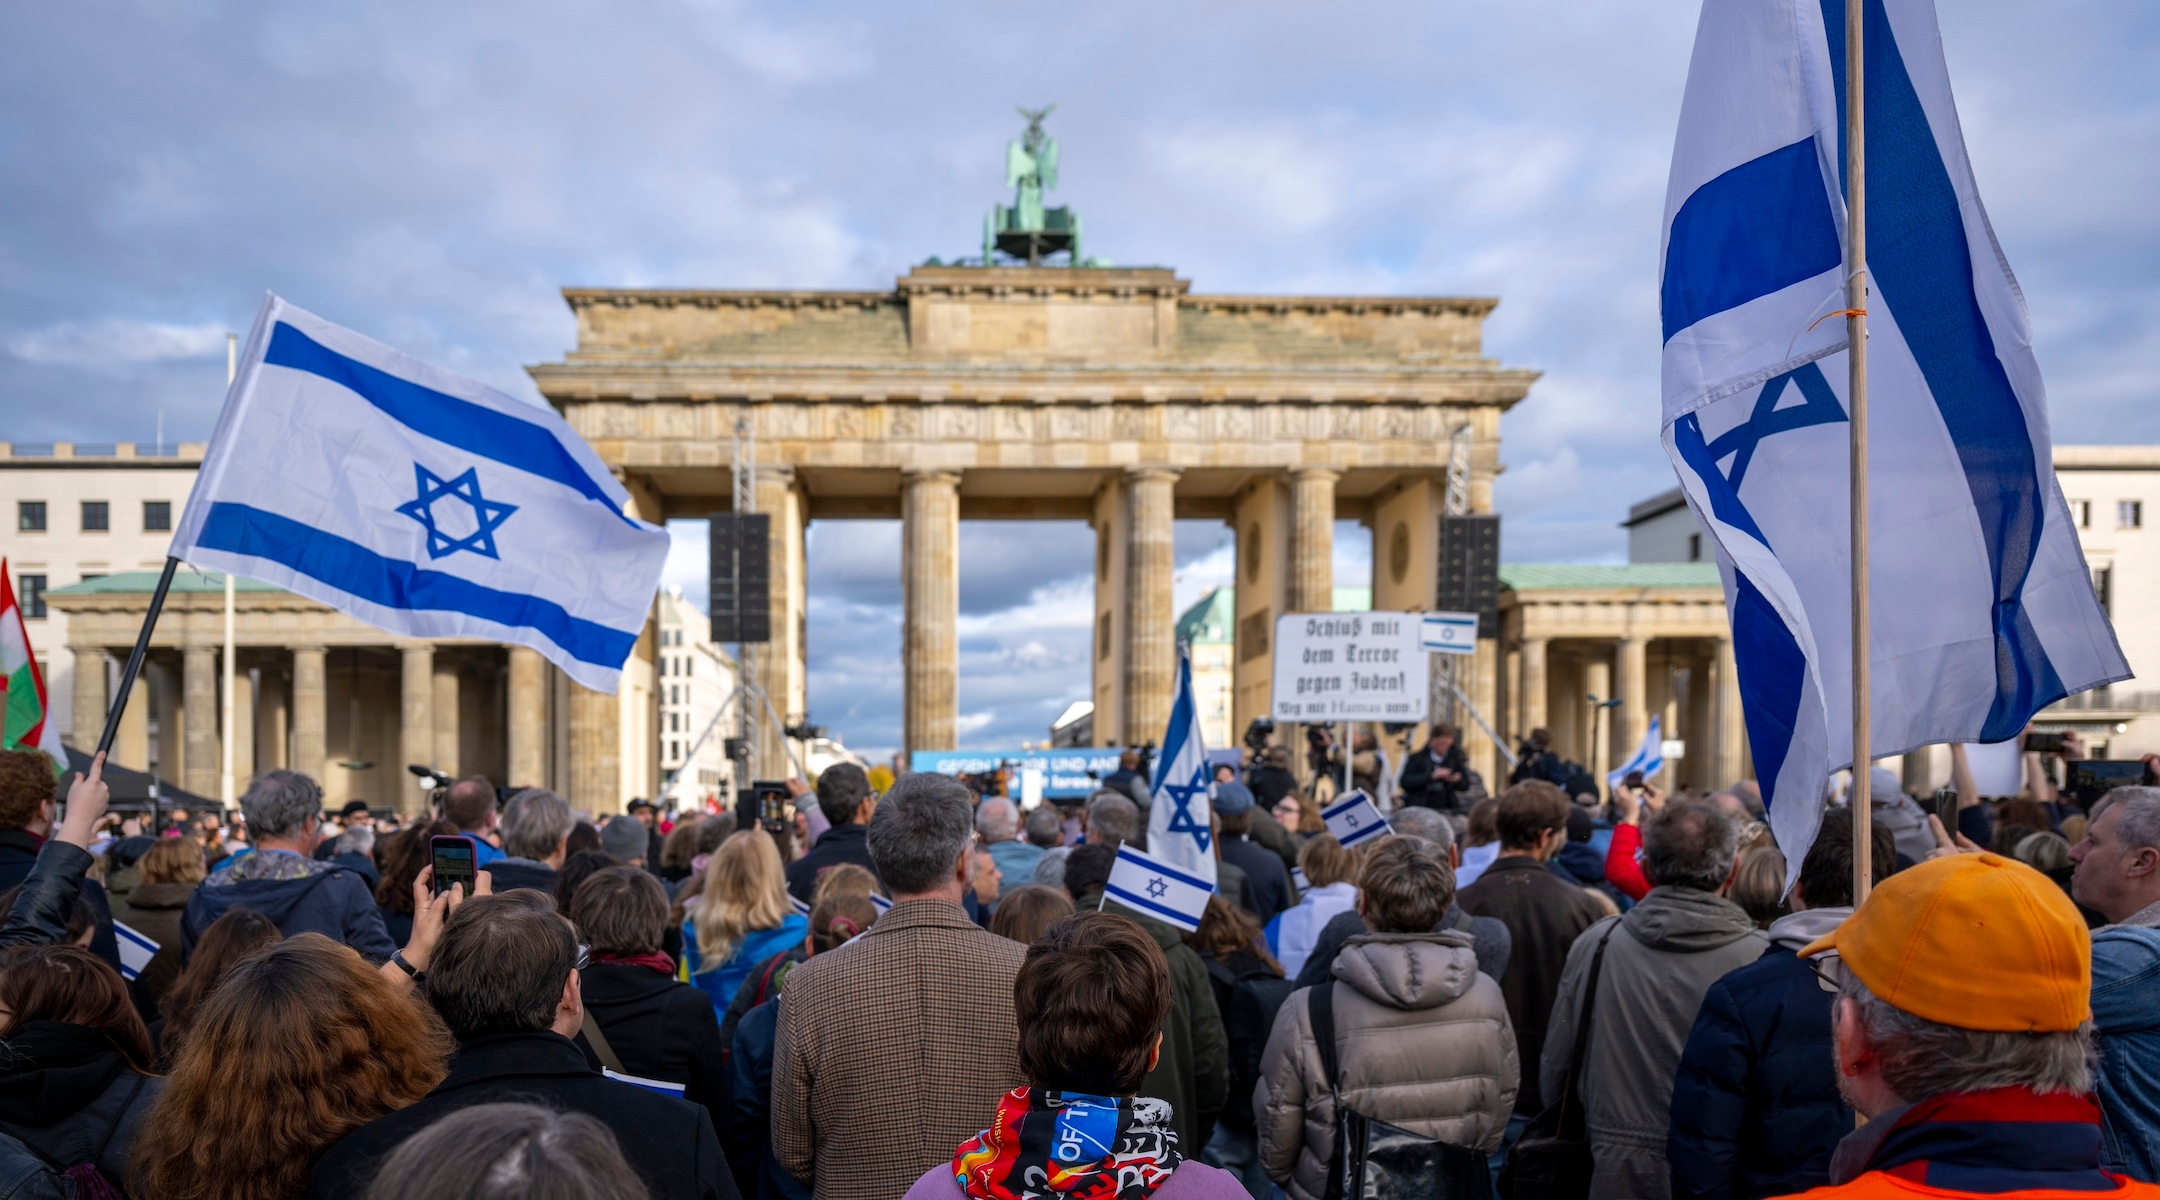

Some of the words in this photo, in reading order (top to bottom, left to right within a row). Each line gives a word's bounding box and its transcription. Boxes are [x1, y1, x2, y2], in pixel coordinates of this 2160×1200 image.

[1306, 617, 1362, 639] Schluß
[1371, 619, 1400, 636] mit
[1302, 647, 1334, 664] dem
[1346, 643, 1399, 664] Terror
[1296, 675, 1342, 694] gegen
[1350, 671, 1405, 694] Juden!
[1306, 701, 1327, 714] mit
[1331, 699, 1382, 714] Hamas
[1058, 1128, 1083, 1162] OF
